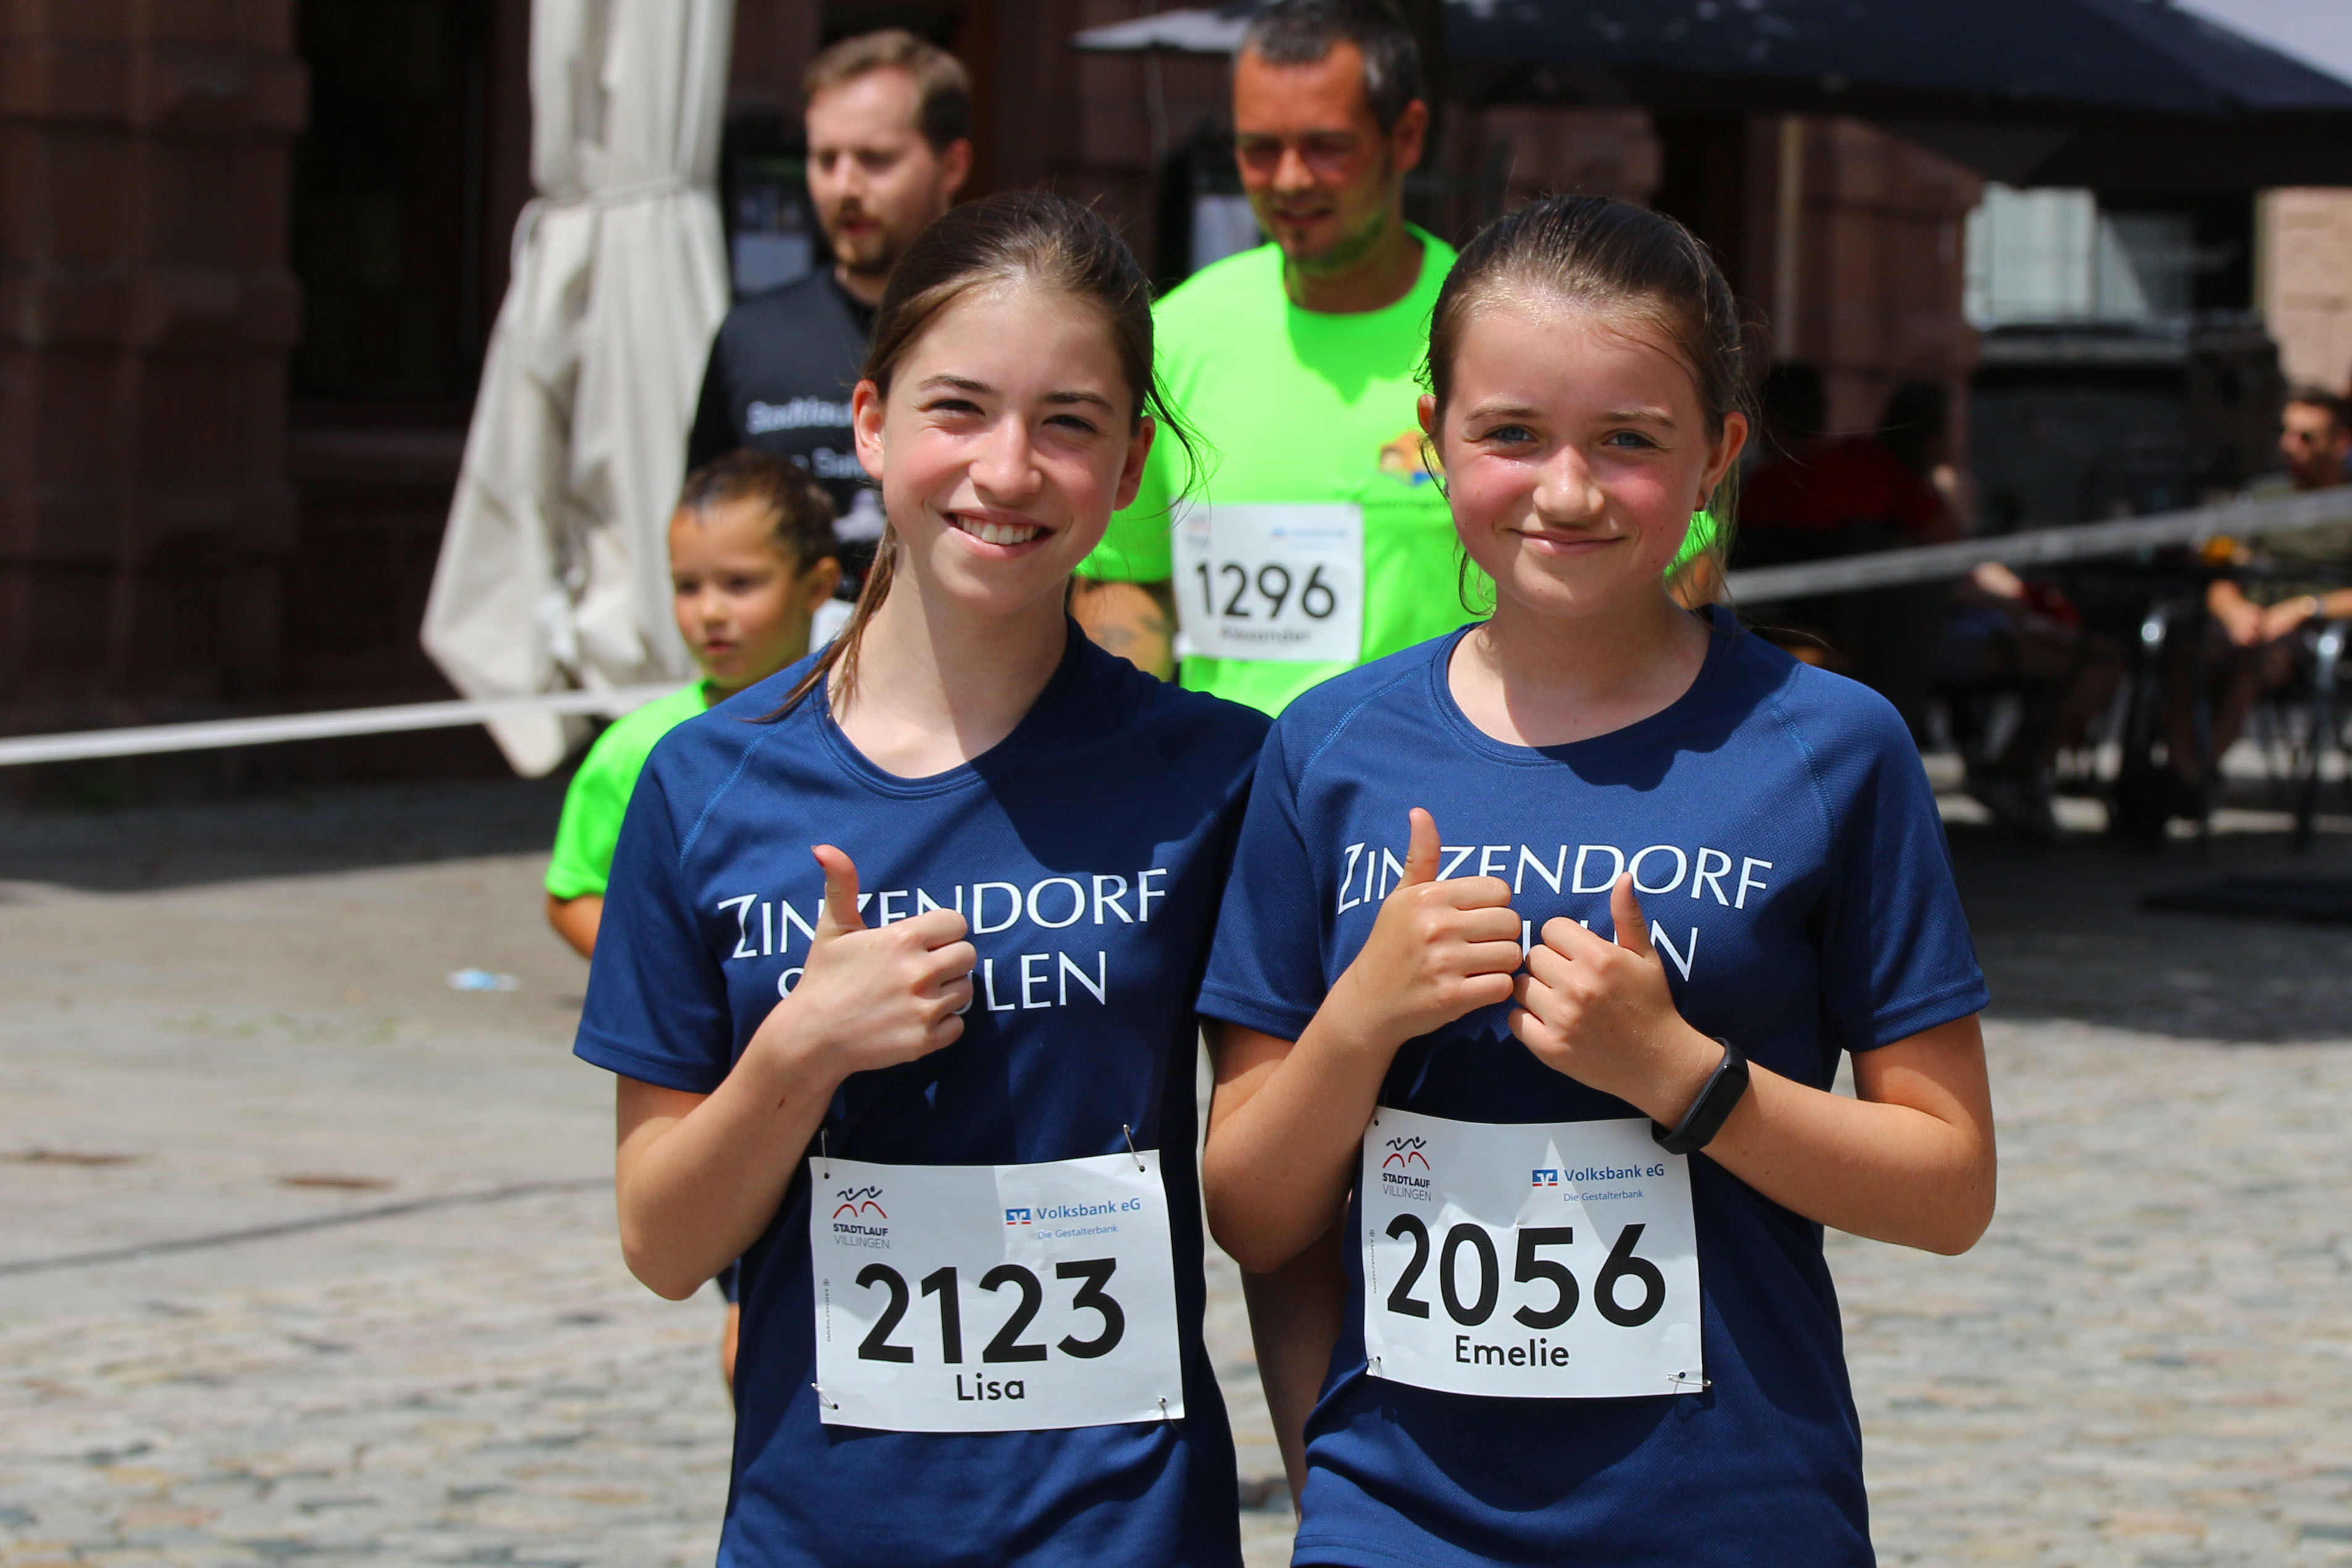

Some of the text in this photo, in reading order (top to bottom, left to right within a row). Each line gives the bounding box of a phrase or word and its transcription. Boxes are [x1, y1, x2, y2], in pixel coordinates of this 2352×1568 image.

[1196, 562, 1335, 619] 1296
[1383, 1173, 1430, 1188] STADTLAUF
[1564, 1163, 1665, 1181] Volksbank eG
[1383, 1184, 1432, 1202] VILLINGEN
[1563, 1189, 1644, 1202] Die Gestalterbank
[1037, 1197, 1141, 1220] Volksbank eG
[833, 1223, 889, 1236] STADTLAUF
[1038, 1224, 1119, 1239] Die Gestalterbank
[834, 1235, 890, 1249] VILLINGEN
[1385, 1213, 1666, 1330] 2056
[855, 1257, 1125, 1364] 2123
[1456, 1335, 1569, 1367] Emelie
[957, 1373, 1025, 1401] Lisa
